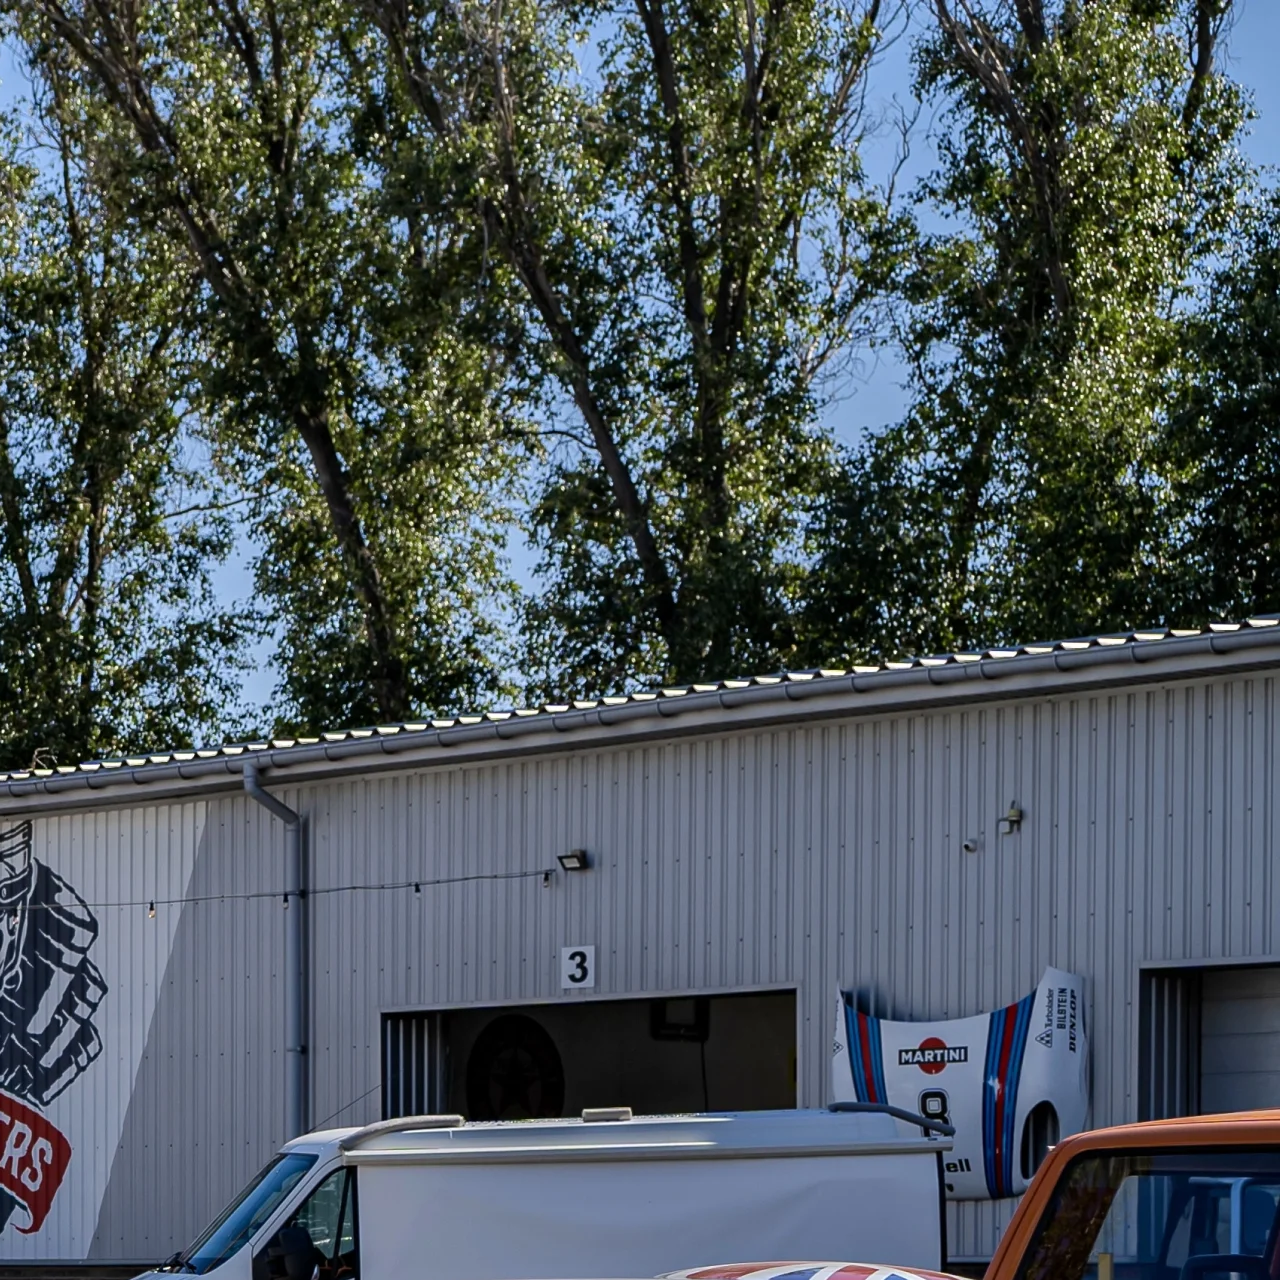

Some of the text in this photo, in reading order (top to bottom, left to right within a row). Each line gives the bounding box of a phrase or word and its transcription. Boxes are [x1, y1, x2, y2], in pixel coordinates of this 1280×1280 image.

[568, 951, 588, 983] 3
[1056, 987, 1068, 1030] BILSTEIN
[1069, 989, 1077, 1053] DUNLOP
[900, 1048, 966, 1064] MARTINI
[945, 1158, 972, 1173] ell
